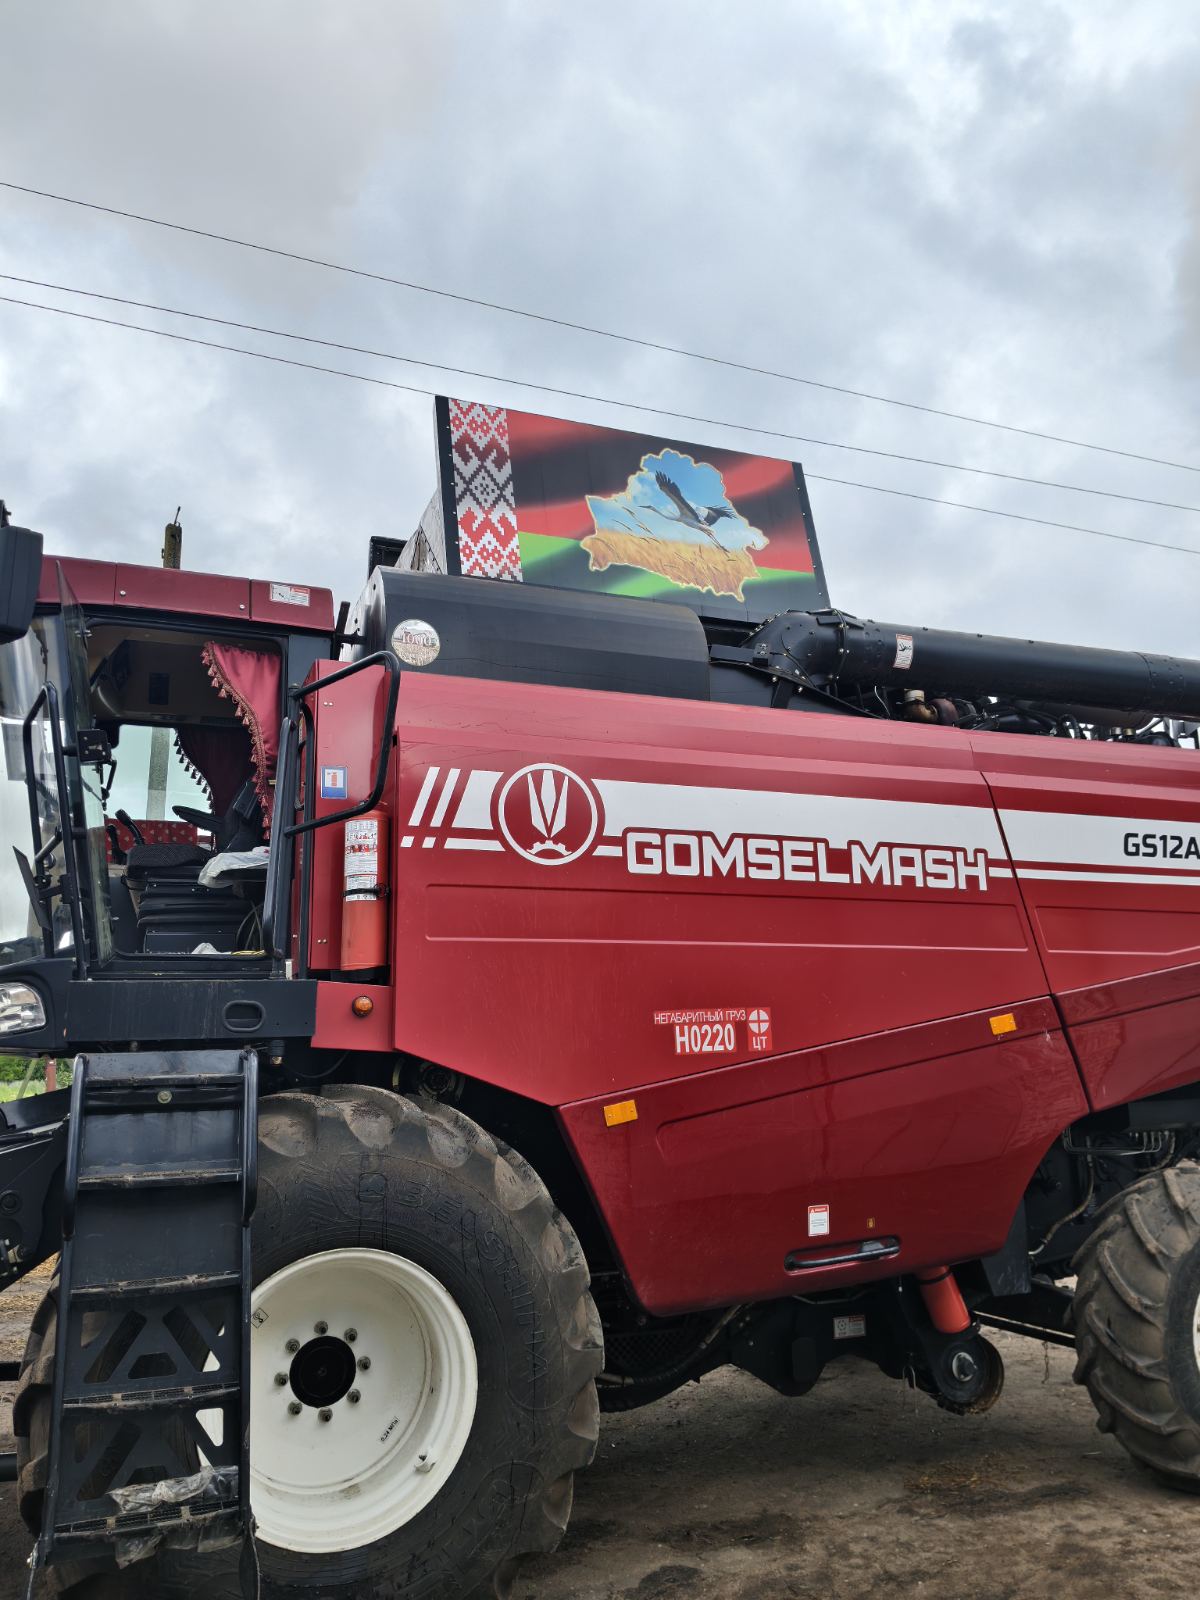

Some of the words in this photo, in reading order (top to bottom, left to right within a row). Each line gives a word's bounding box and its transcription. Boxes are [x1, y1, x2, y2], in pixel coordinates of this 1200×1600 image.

[1123, 832, 1200, 859] GS12A
[626, 831, 988, 891] GOMSELMASH
[654, 1009, 723, 1024] НЕГАБАРИТНЫЙ
[725, 1010, 746, 1021] ГРУЗ
